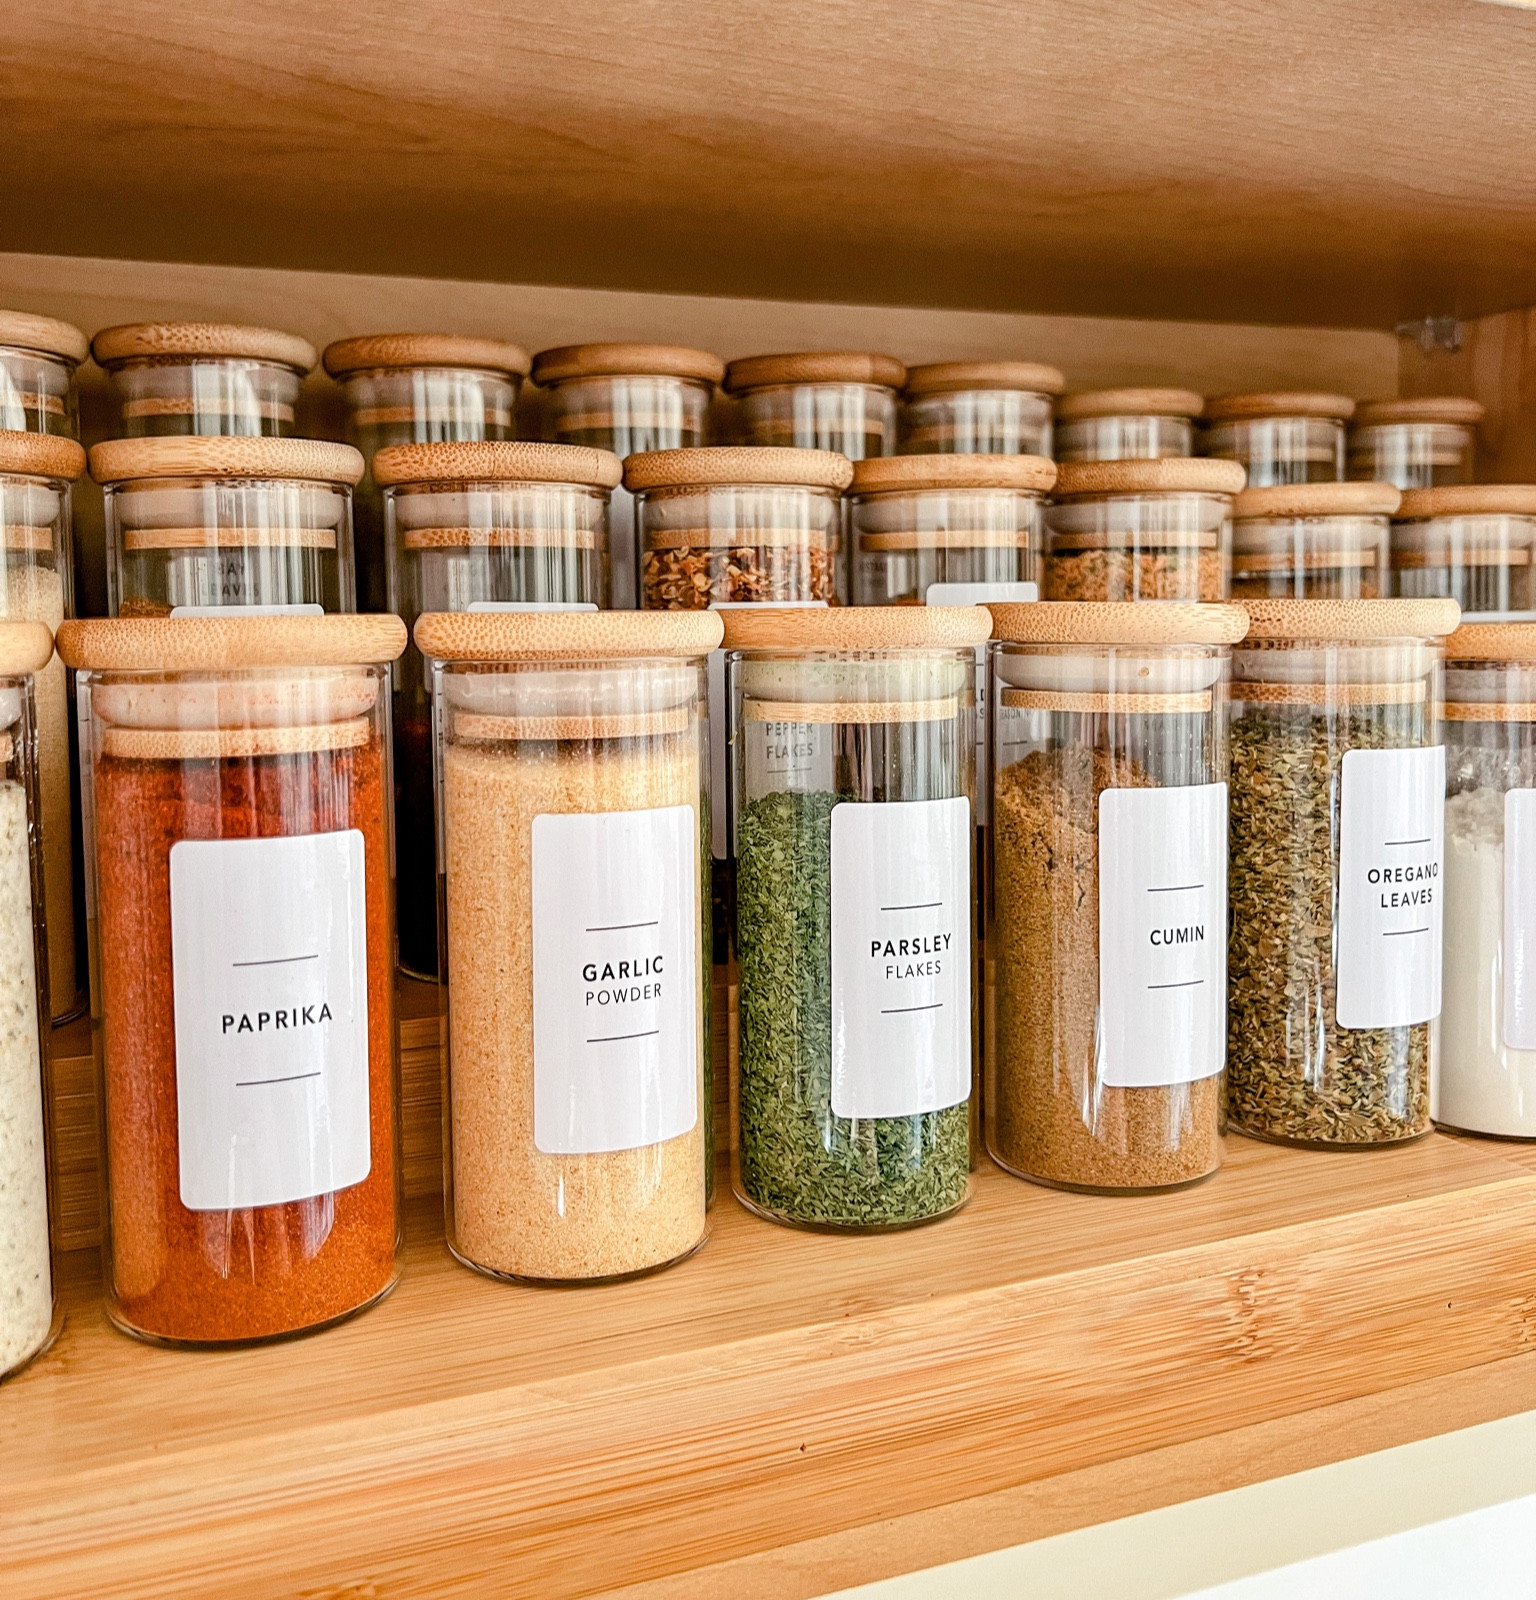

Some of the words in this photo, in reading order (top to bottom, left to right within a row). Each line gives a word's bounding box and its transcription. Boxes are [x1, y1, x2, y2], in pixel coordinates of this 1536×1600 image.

[766, 722, 813, 737] PEPPER
[766, 743, 813, 760] FLAKES
[1367, 861, 1439, 884] OREGANO
[1381, 887, 1433, 908] LEAVES
[871, 932, 952, 958] PARSLEY
[1150, 924, 1204, 946] CUMIN
[582, 955, 664, 982] GARLIC
[886, 959, 941, 980] FLAKES
[586, 982, 662, 1006] POWDER
[222, 1003, 333, 1035] PAPRIKA
